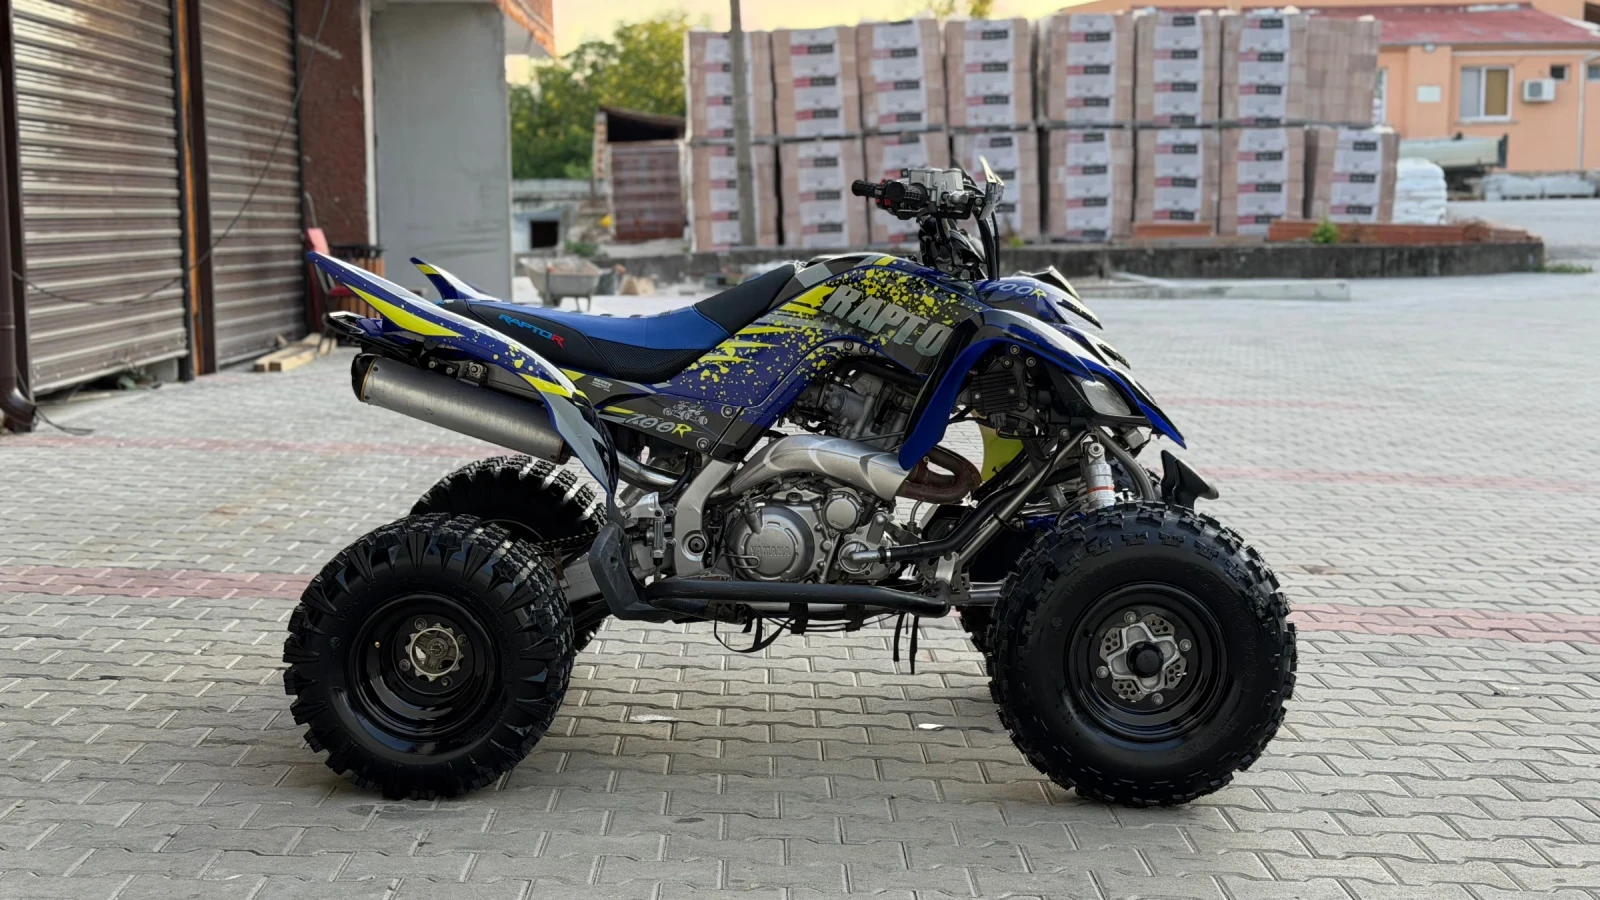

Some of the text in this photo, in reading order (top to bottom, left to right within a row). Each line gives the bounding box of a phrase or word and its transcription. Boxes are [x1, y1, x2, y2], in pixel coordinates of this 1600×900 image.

[985, 282, 1048, 301] 700R
[498, 313, 564, 348] RAPTOR
[820, 284, 953, 357] RAPTO
[625, 413, 693, 439] 700R
[749, 545, 790, 557] YAMAHA
